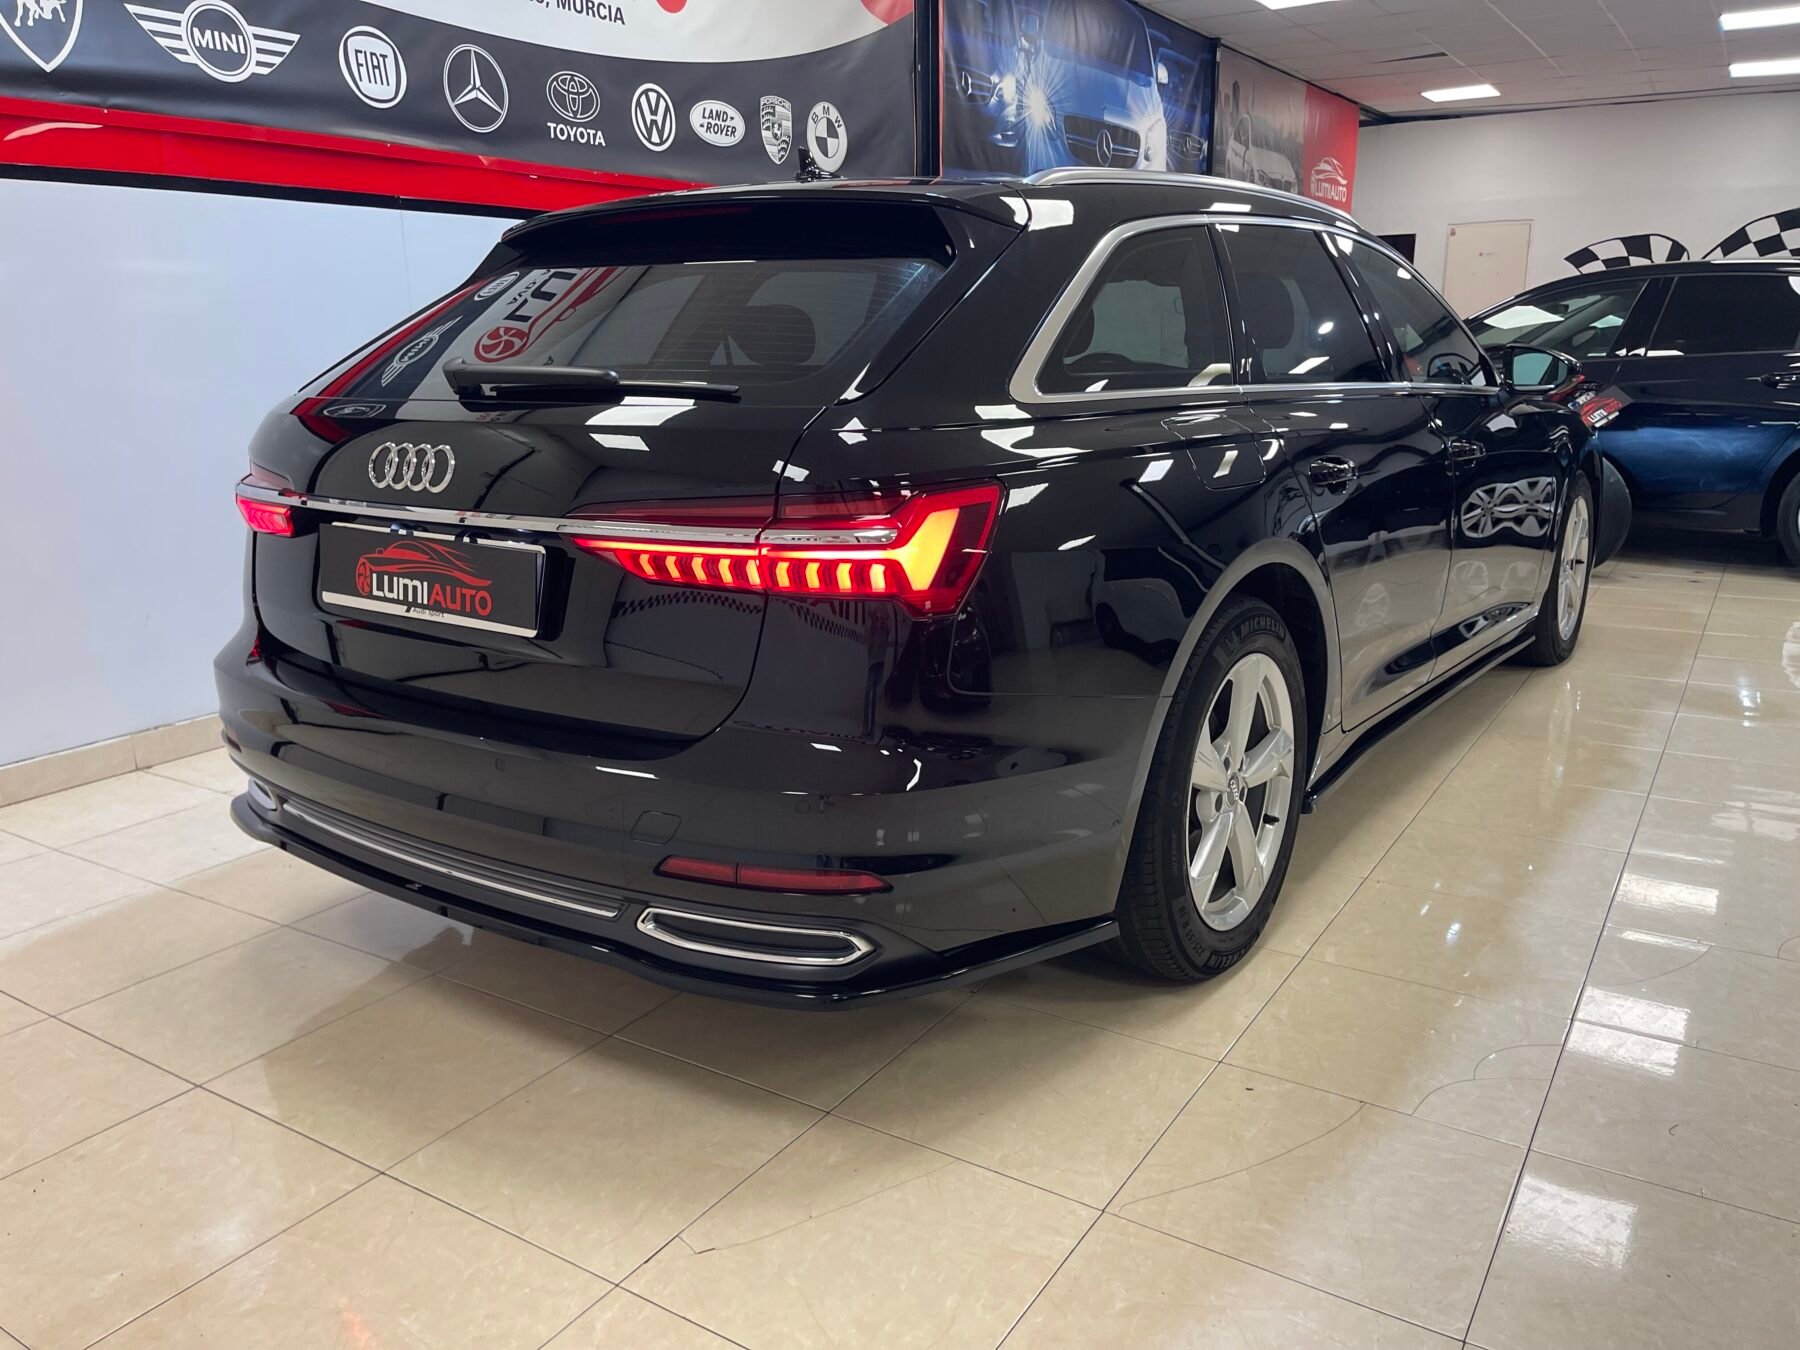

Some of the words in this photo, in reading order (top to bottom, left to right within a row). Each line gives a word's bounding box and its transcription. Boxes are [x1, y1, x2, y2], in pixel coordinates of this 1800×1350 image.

[556, 0, 625, 25] MURCIA
[193, 27, 246, 55] MINI
[354, 48, 390, 86] FIAT
[547, 122, 606, 146] TOYOTA
